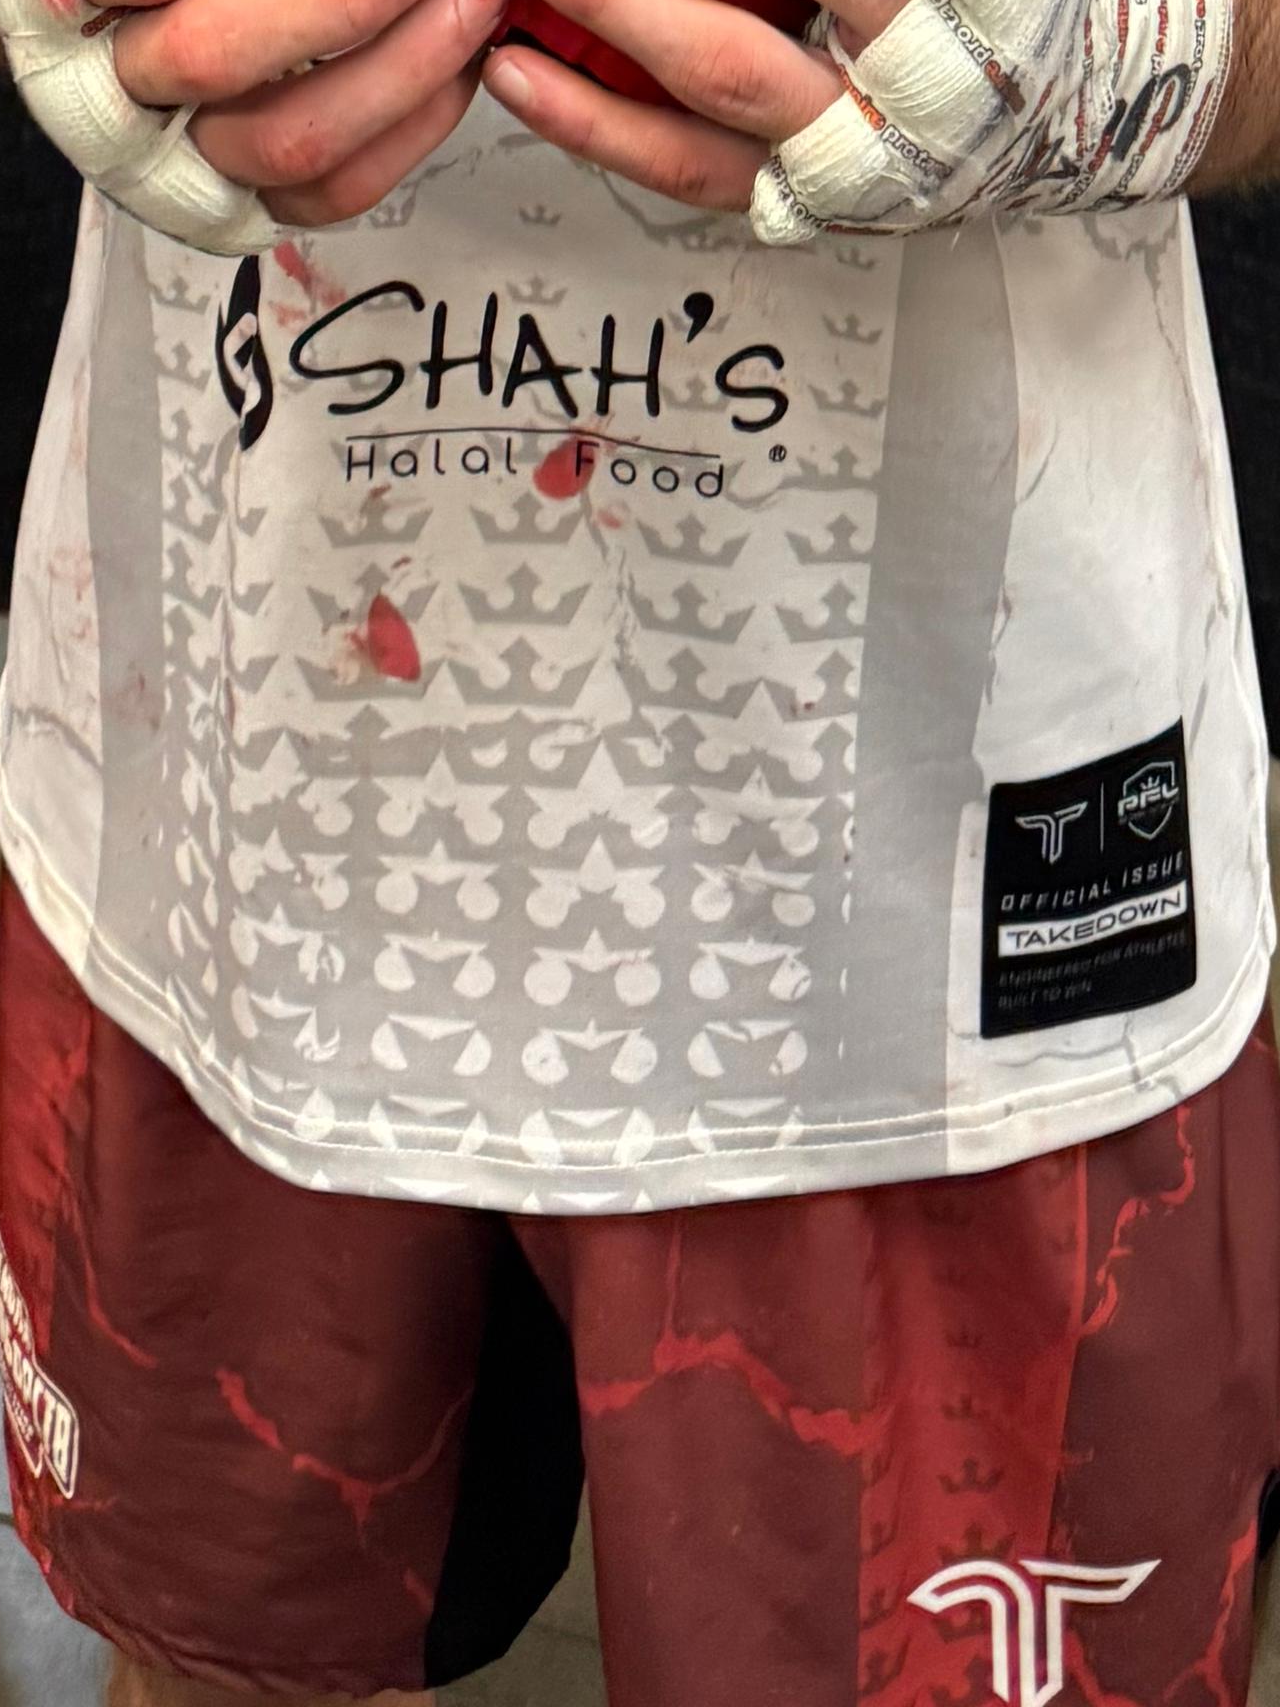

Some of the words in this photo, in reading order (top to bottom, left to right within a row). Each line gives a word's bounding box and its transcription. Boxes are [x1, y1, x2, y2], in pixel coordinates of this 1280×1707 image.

[346, 438, 518, 482] Halal
[574, 441, 725, 498] Food
[1001, 878, 1112, 912] OFFICIAL
[1006, 890, 1181, 950] TAKEDOWN
